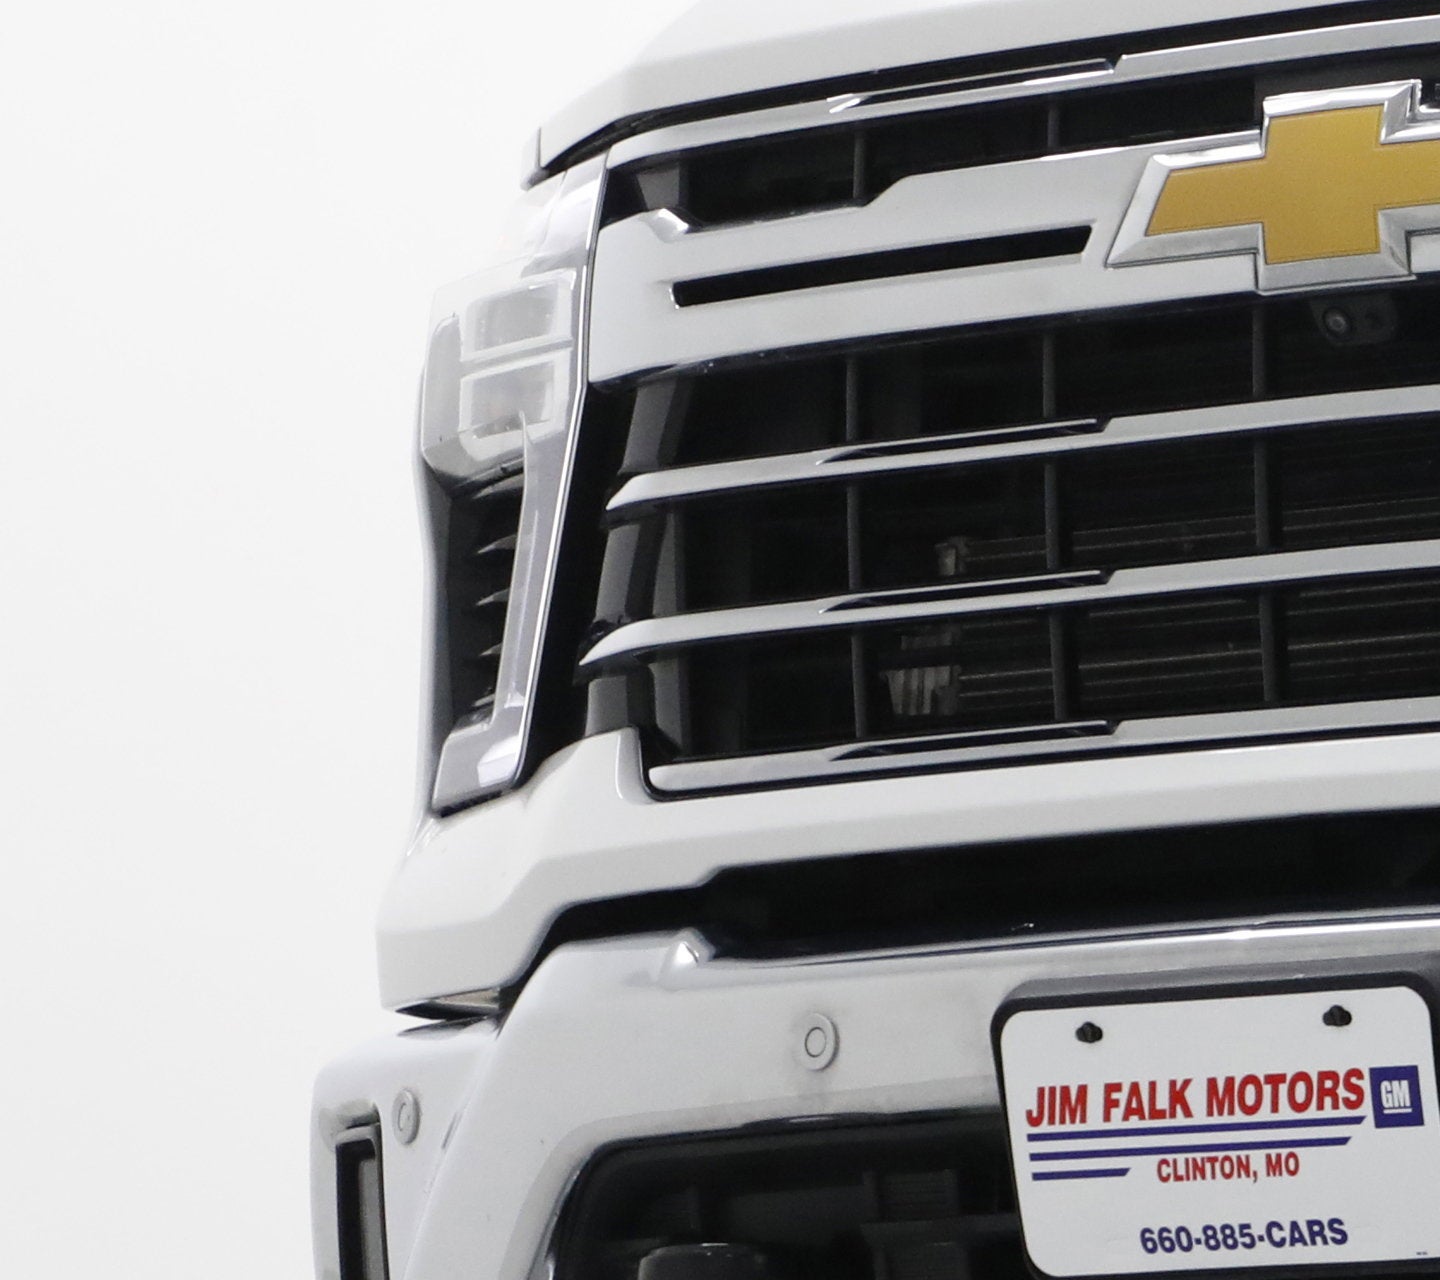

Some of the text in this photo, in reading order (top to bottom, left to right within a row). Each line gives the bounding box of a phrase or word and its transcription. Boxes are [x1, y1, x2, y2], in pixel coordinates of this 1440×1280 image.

[1026, 1067, 1365, 1128] JIM FALK MOTORS
[1380, 1079, 1411, 1109] GM
[1157, 1152, 1300, 1184] CLINTON, MO
[1139, 1217, 1349, 1255] 660-885-CARS
